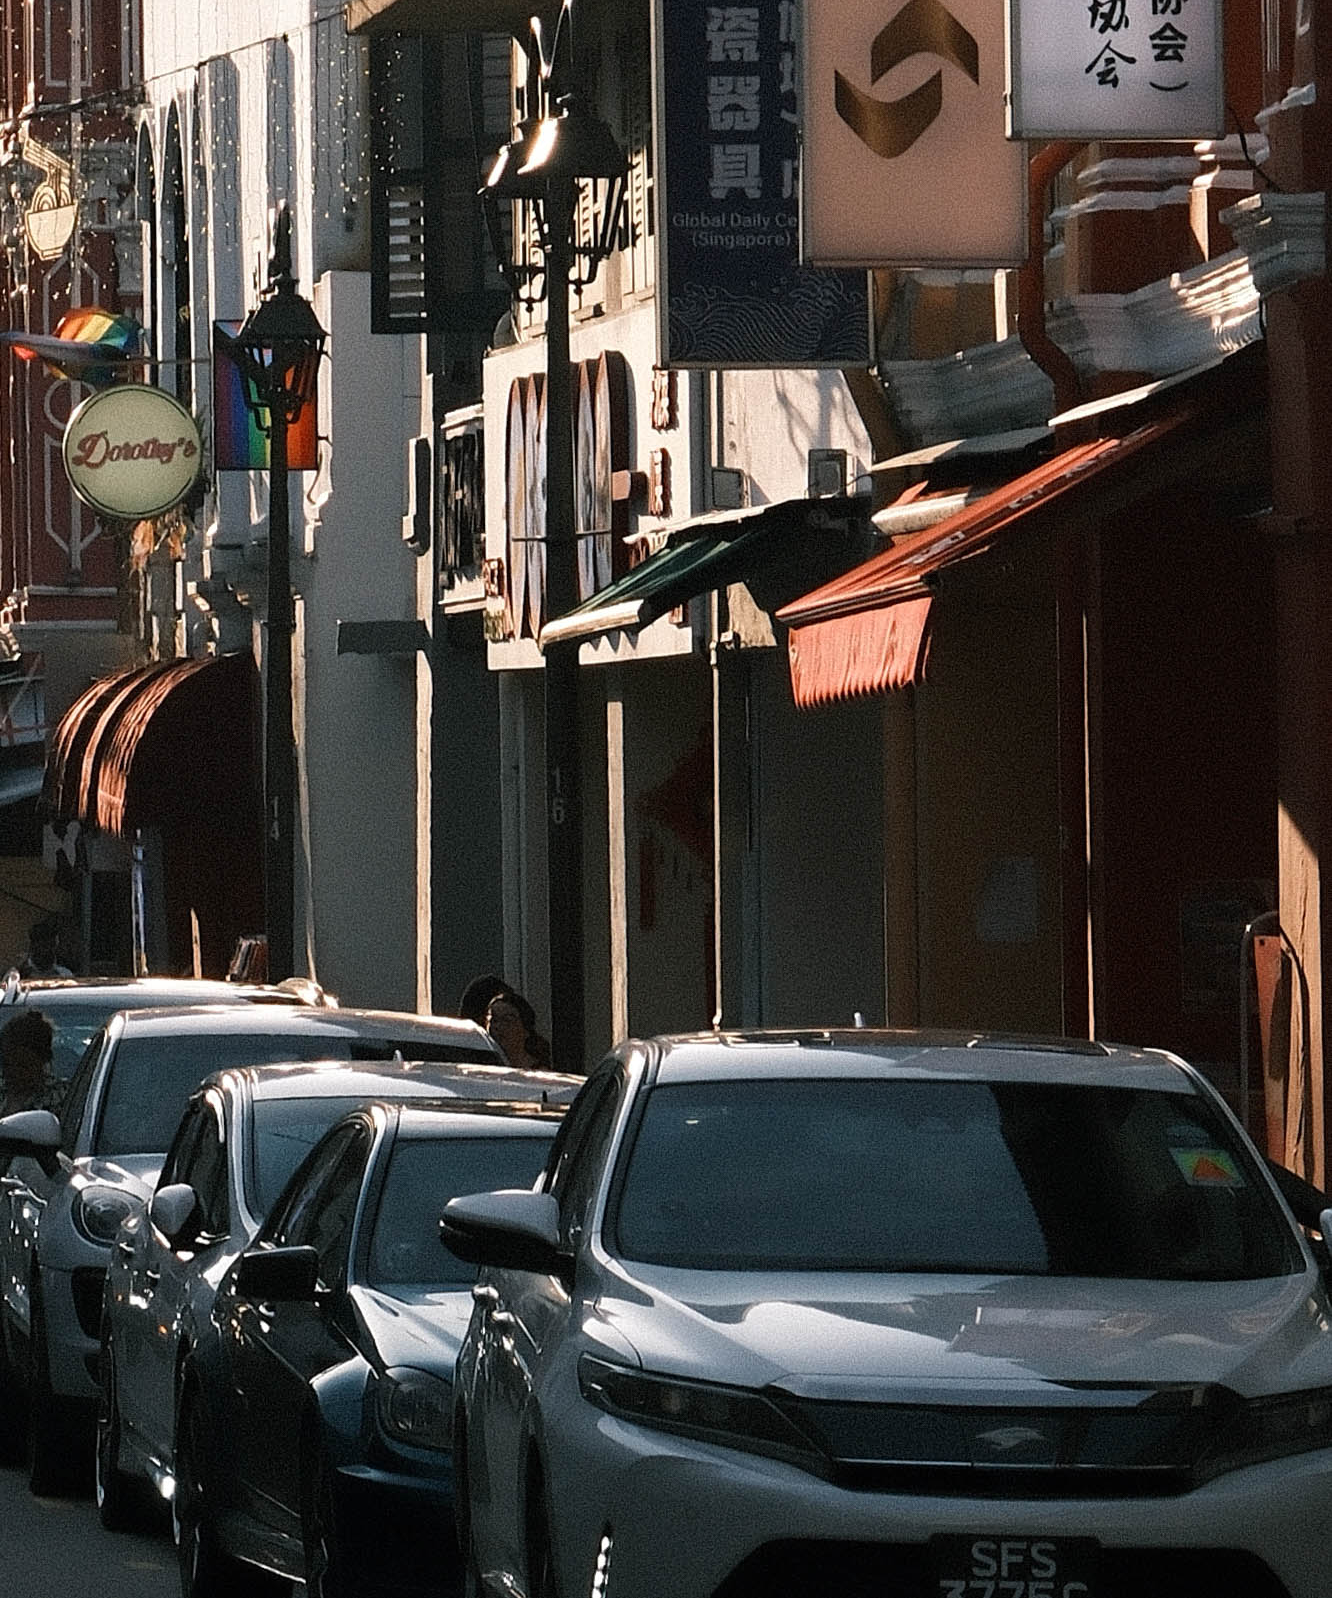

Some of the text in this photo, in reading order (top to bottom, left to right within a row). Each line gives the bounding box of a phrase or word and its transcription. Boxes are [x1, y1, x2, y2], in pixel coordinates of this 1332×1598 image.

[672, 211, 727, 229] Global
[730, 211, 772, 231] Daily
[692, 228, 792, 251] (Singapore)
[72, 430, 197, 469] Dorothy's
[971, 1540, 1057, 1579] SFS
